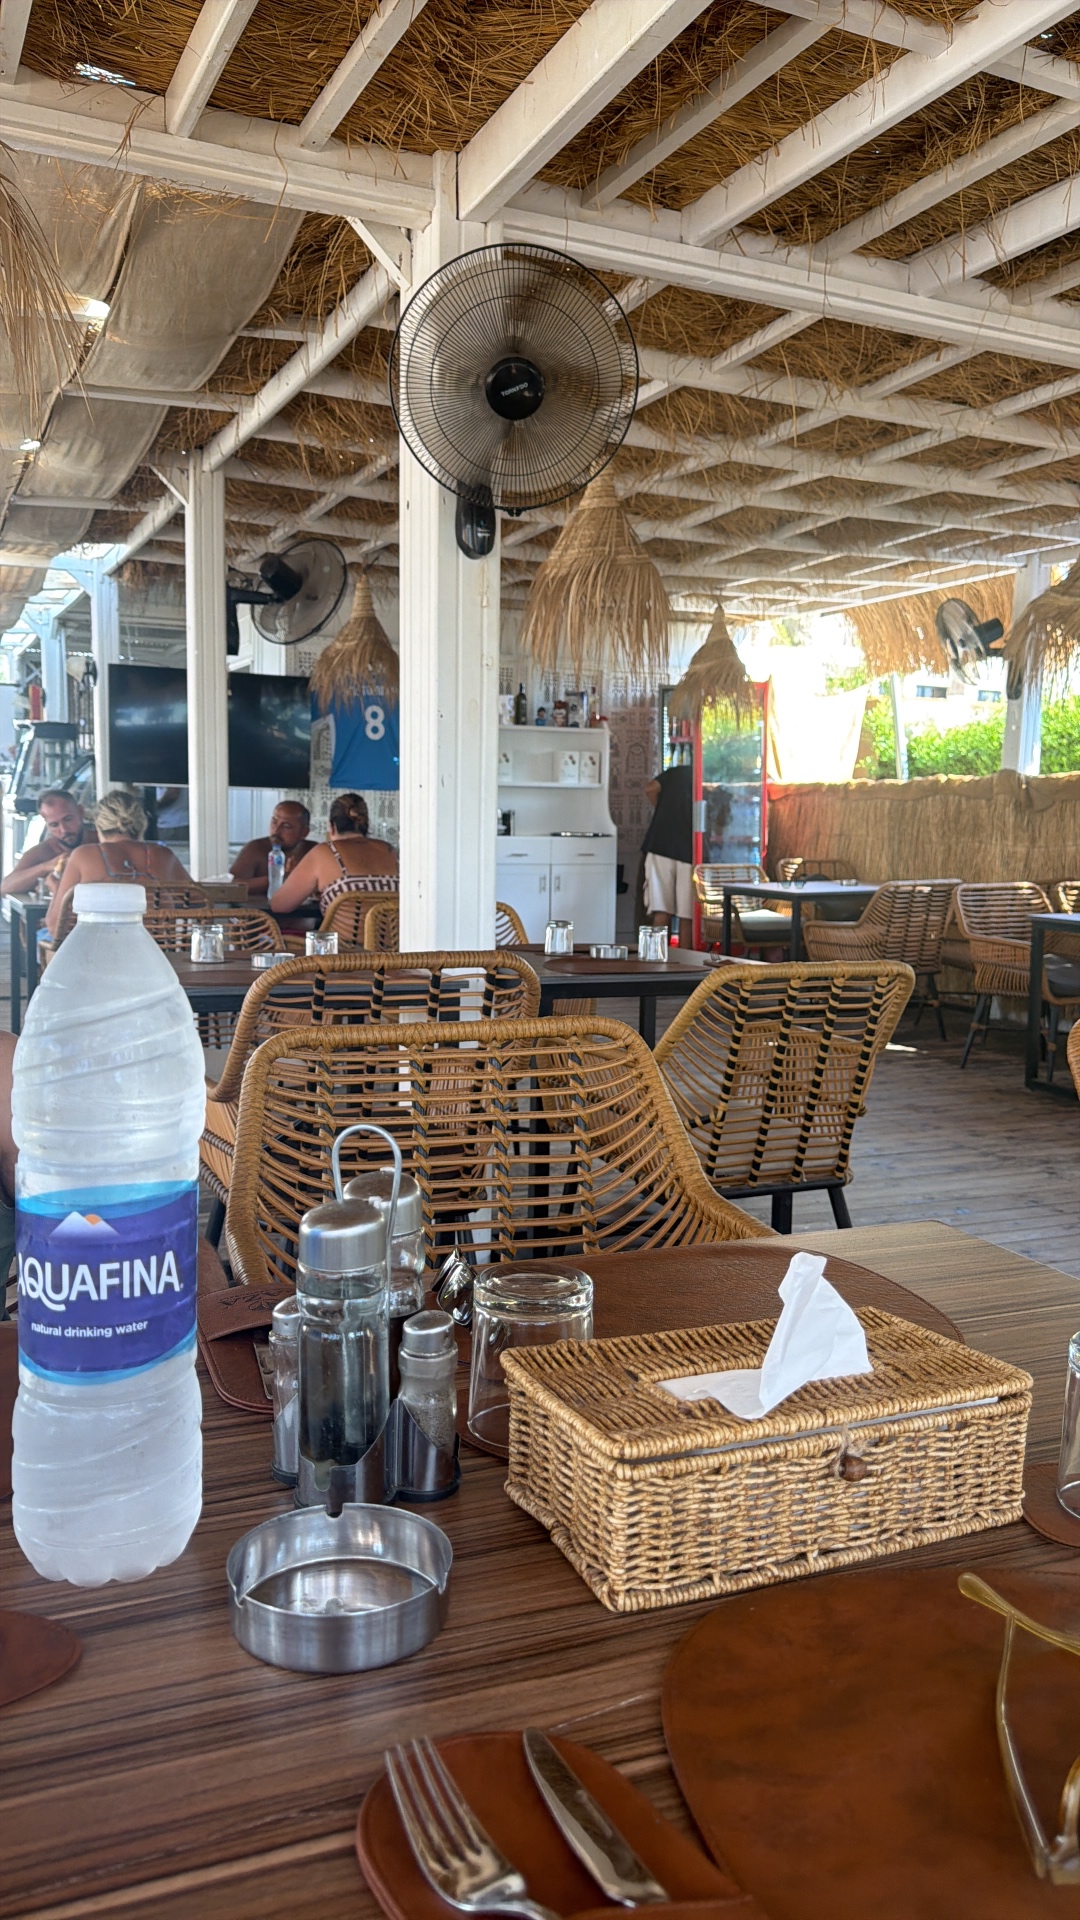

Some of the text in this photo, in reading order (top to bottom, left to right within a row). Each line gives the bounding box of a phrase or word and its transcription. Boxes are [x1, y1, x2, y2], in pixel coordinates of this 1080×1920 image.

[365, 704, 385, 741] 8
[31, 1320, 148, 1338] natural drinking water
